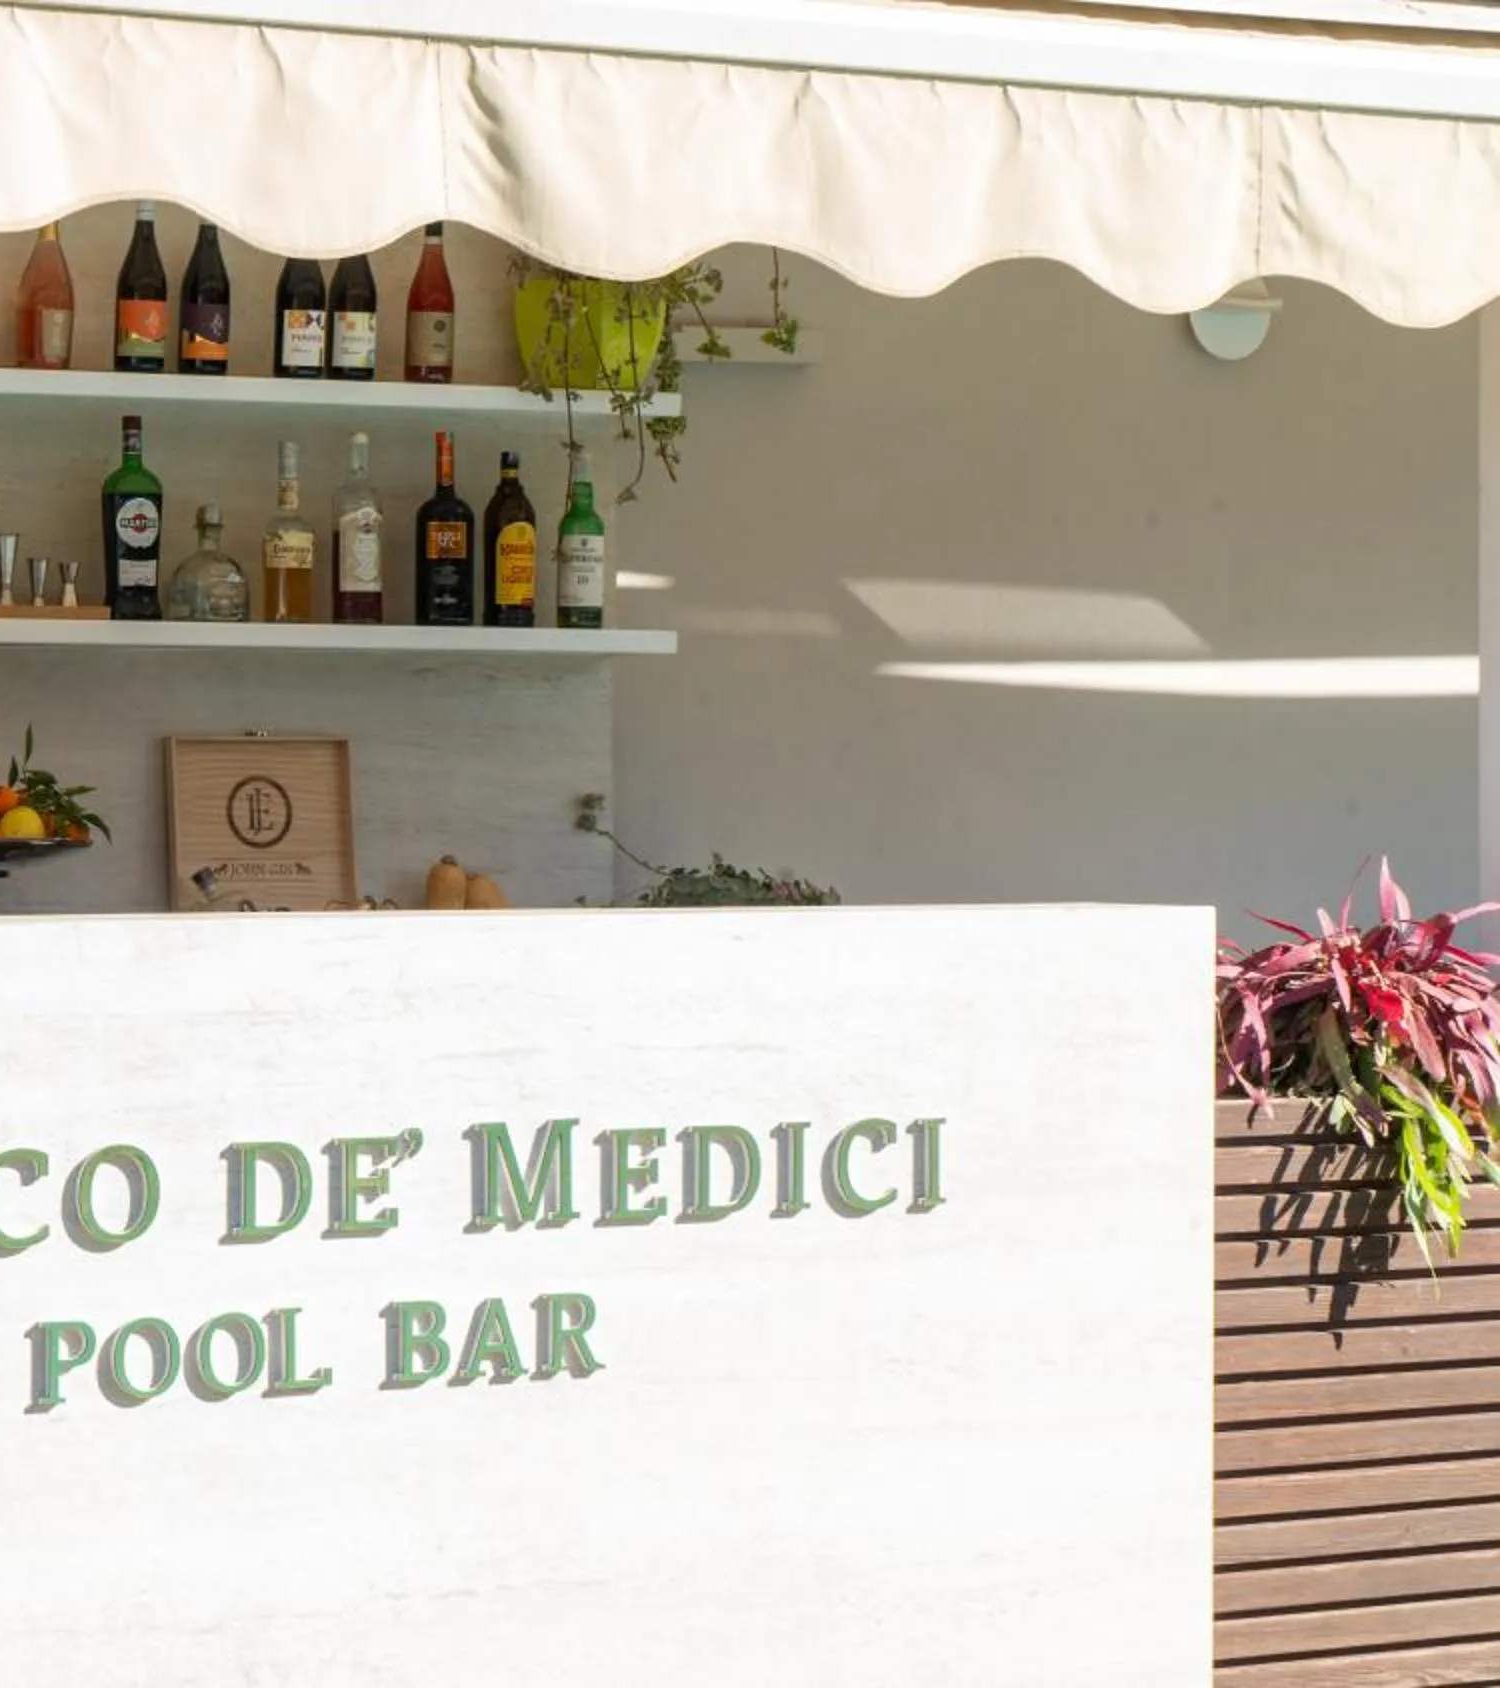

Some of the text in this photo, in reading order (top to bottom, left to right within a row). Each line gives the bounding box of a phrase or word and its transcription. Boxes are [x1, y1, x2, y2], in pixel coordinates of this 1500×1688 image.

[463, 1117, 946, 1233] MEDICI
[24, 1293, 605, 1413] POOL BAR
